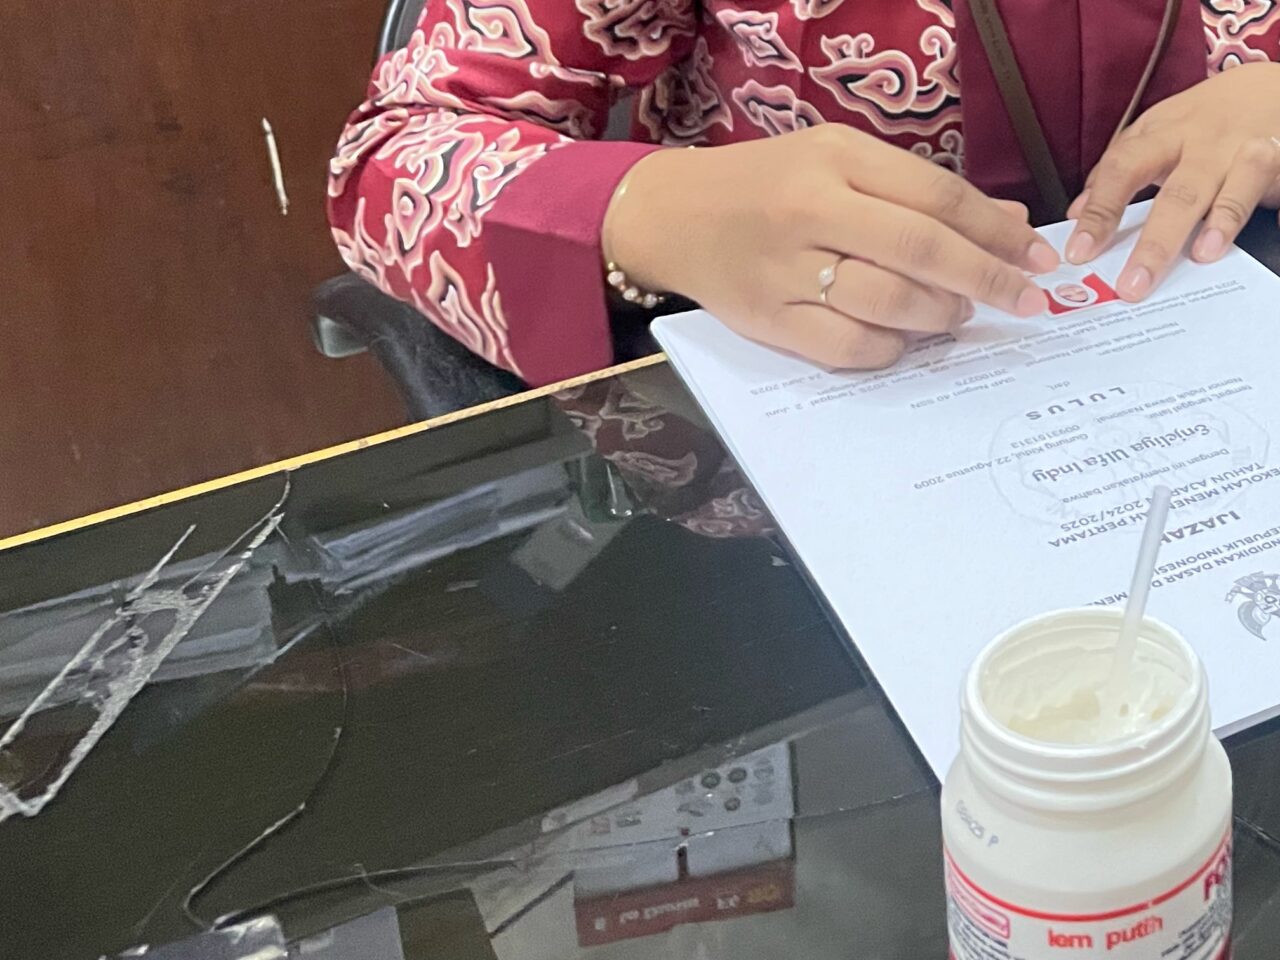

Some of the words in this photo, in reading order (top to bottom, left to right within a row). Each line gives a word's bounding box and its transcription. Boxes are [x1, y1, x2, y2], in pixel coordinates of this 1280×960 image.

[1026, 387, 1126, 421] LULUS
[1129, 424, 1210, 452] Enjeliya
[994, 455, 1012, 466] 22
[1082, 448, 1130, 467] Ulfa
[913, 475, 945, 490] 2009
[1031, 462, 1084, 482] Indy
[1210, 462, 1265, 484] TAHUN
[1060, 500, 1144, 532] 2024/2025
[1048, 518, 1128, 547] PERTAMA
[1150, 547, 1223, 575] INDONESI
[1165, 562, 1214, 583] DASAR
[1086, 591, 1131, 606] MEN
[1048, 928, 1093, 949] lem
[1106, 915, 1163, 950] putih
